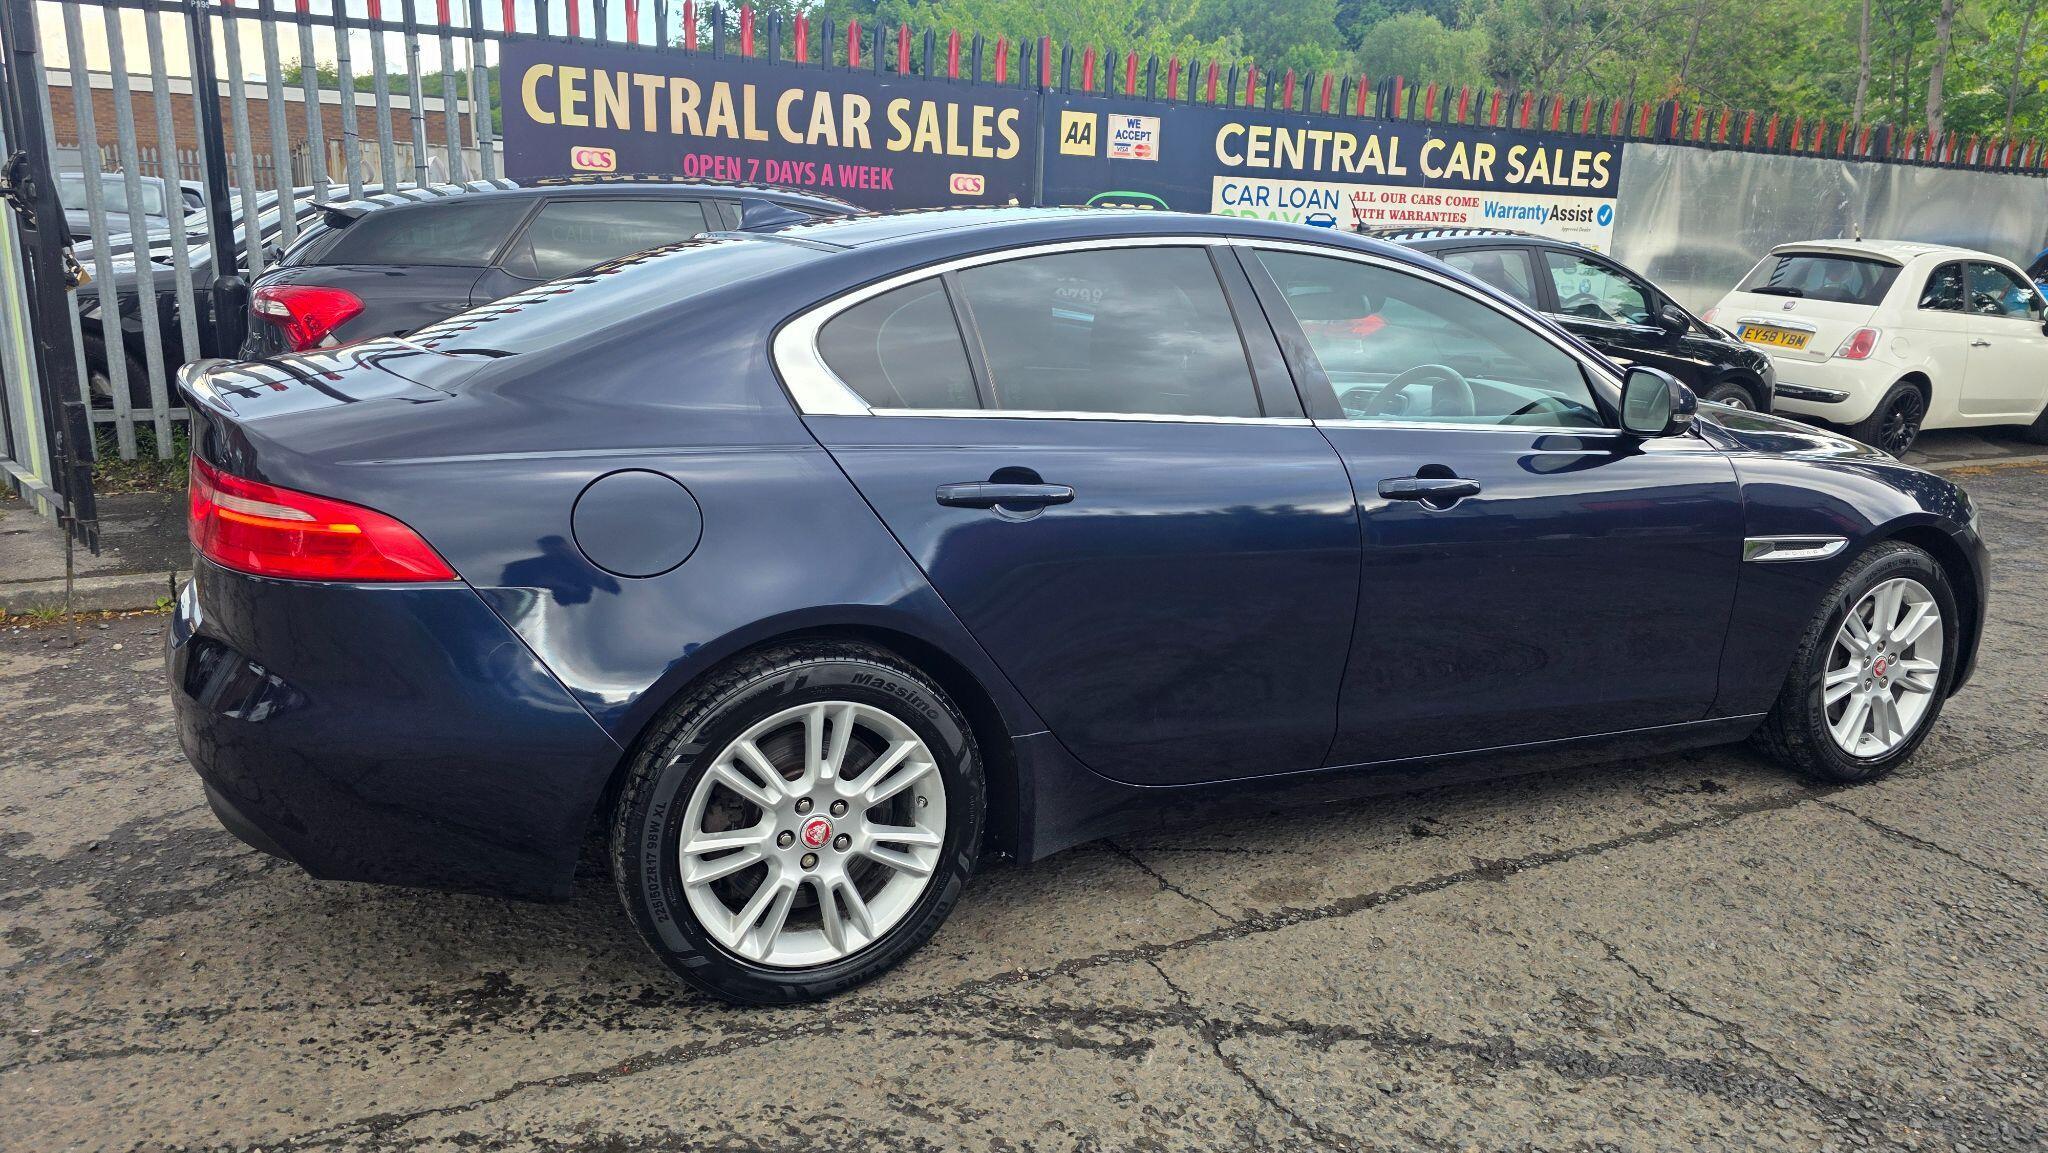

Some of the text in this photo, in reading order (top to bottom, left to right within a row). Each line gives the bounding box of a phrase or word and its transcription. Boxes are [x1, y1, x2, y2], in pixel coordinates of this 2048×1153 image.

[521, 63, 1021, 160] CENTRAL CAR SALES
[1126, 118, 1142, 129] WE
[1065, 121, 1091, 145] AA
[1115, 129, 1152, 142] ACCEPT
[1215, 122, 1612, 189] CENTRAL CAR SALES
[683, 153, 895, 191] OPEN 7 DAYS A WEEK
[1221, 183, 1340, 210] CAR LOAN
[1353, 191, 1480, 208] ALL OUR CARS COME
[1352, 207, 1467, 223] WITH WARRANTIES
[1744, 328, 1806, 347] EY58 YBM
[851, 673, 939, 720] Massimo
